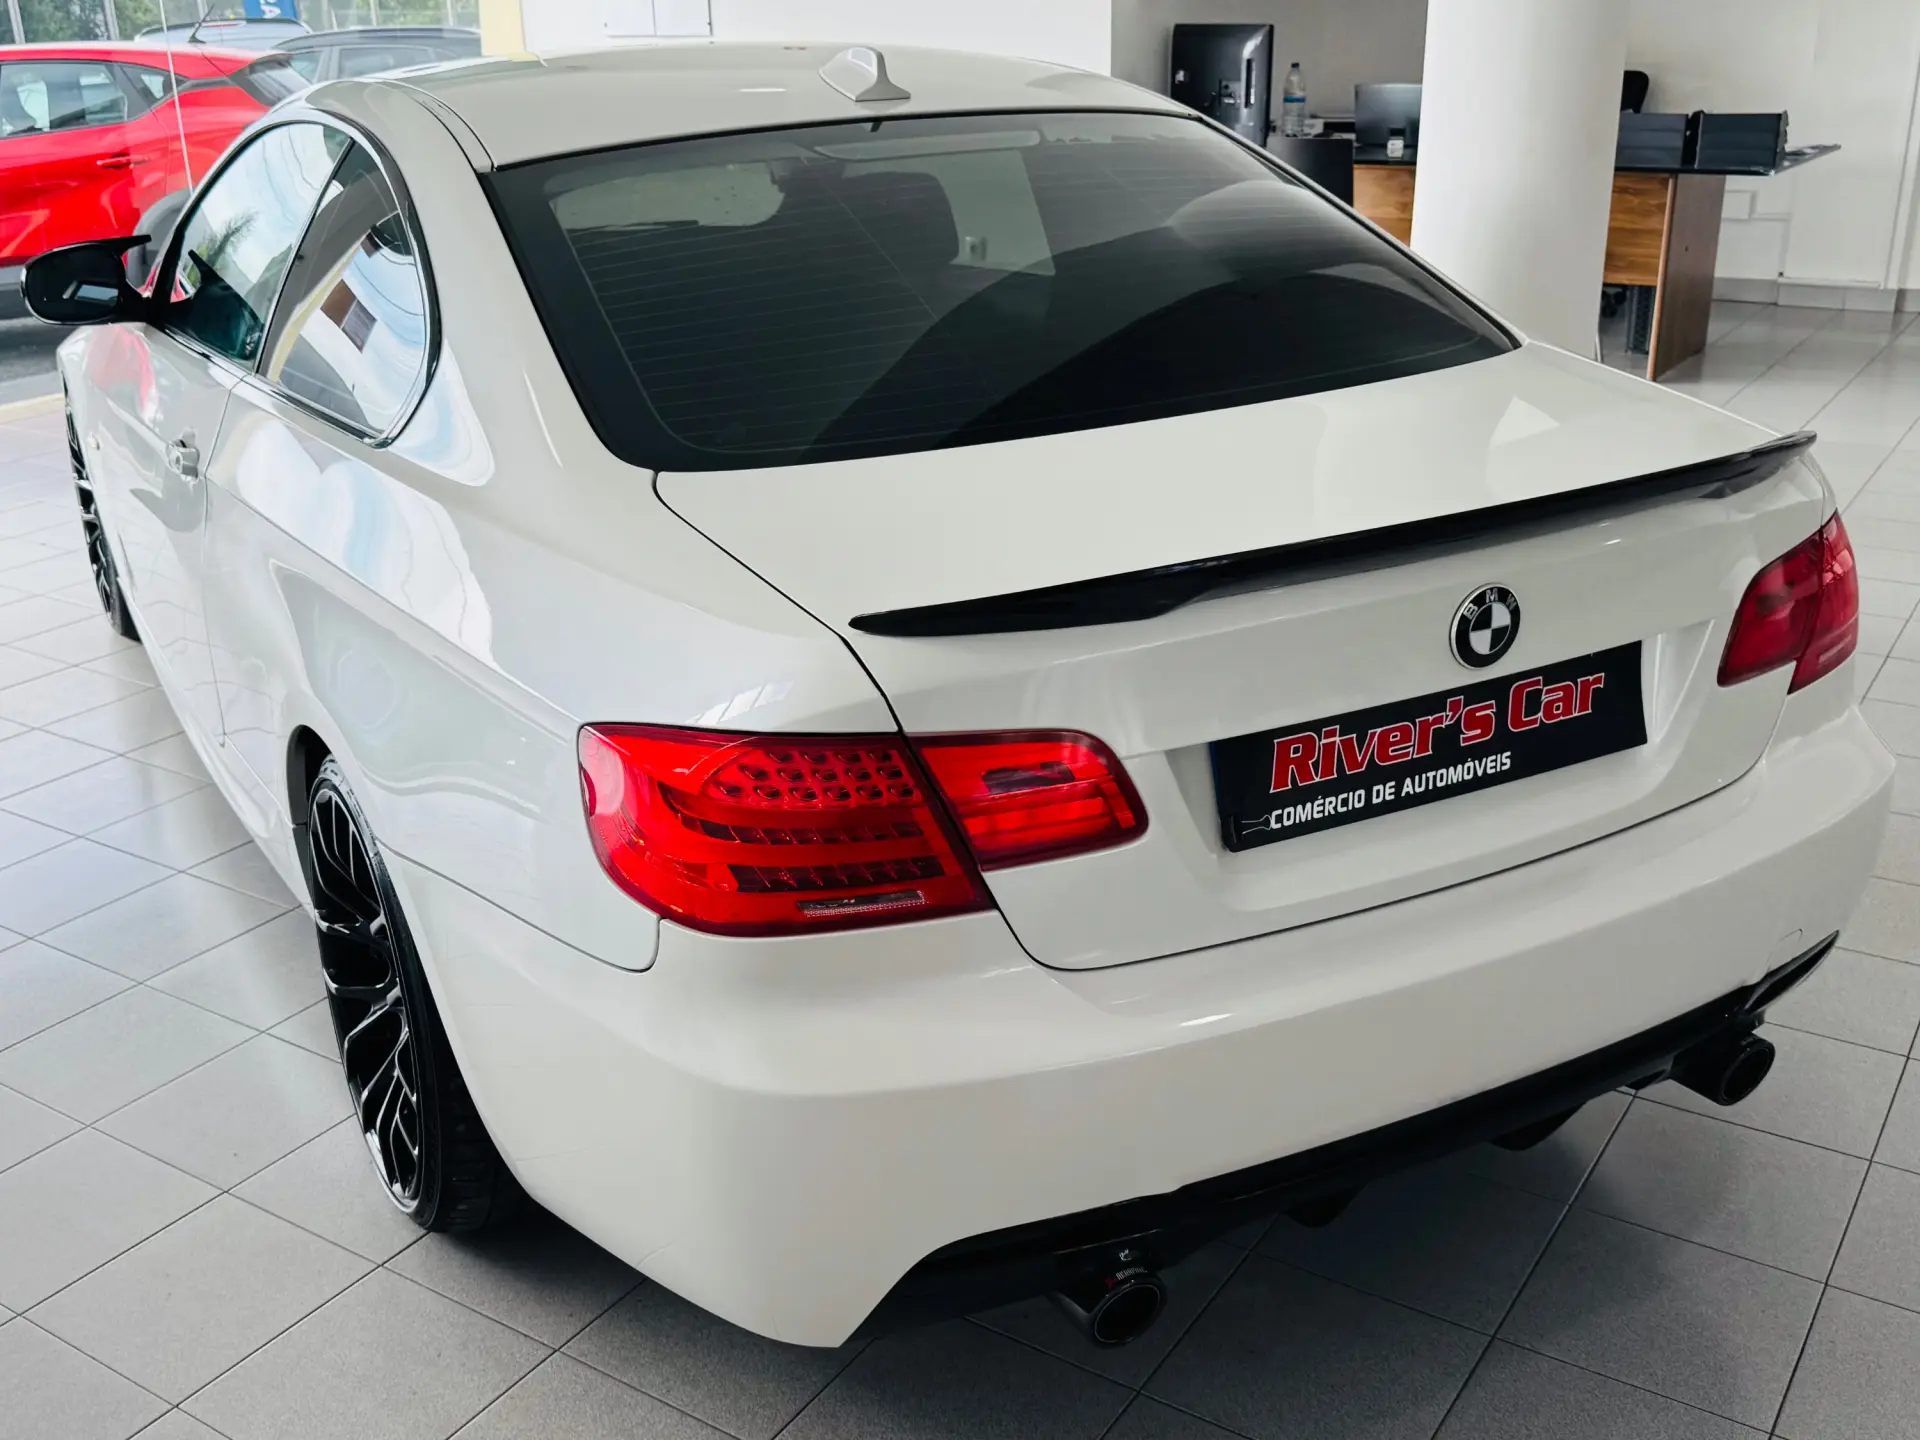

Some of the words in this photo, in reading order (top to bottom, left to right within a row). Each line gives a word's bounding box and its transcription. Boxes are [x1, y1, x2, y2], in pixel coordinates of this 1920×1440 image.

[1462, 588, 1518, 620] BMW
[1269, 696, 1496, 793] River's
[1508, 673, 1605, 732] Car
[1271, 789, 1365, 829] COMÉRCIO
[1372, 781, 1396, 804] DE
[1401, 751, 1511, 796] AUTOMÓVEIS
